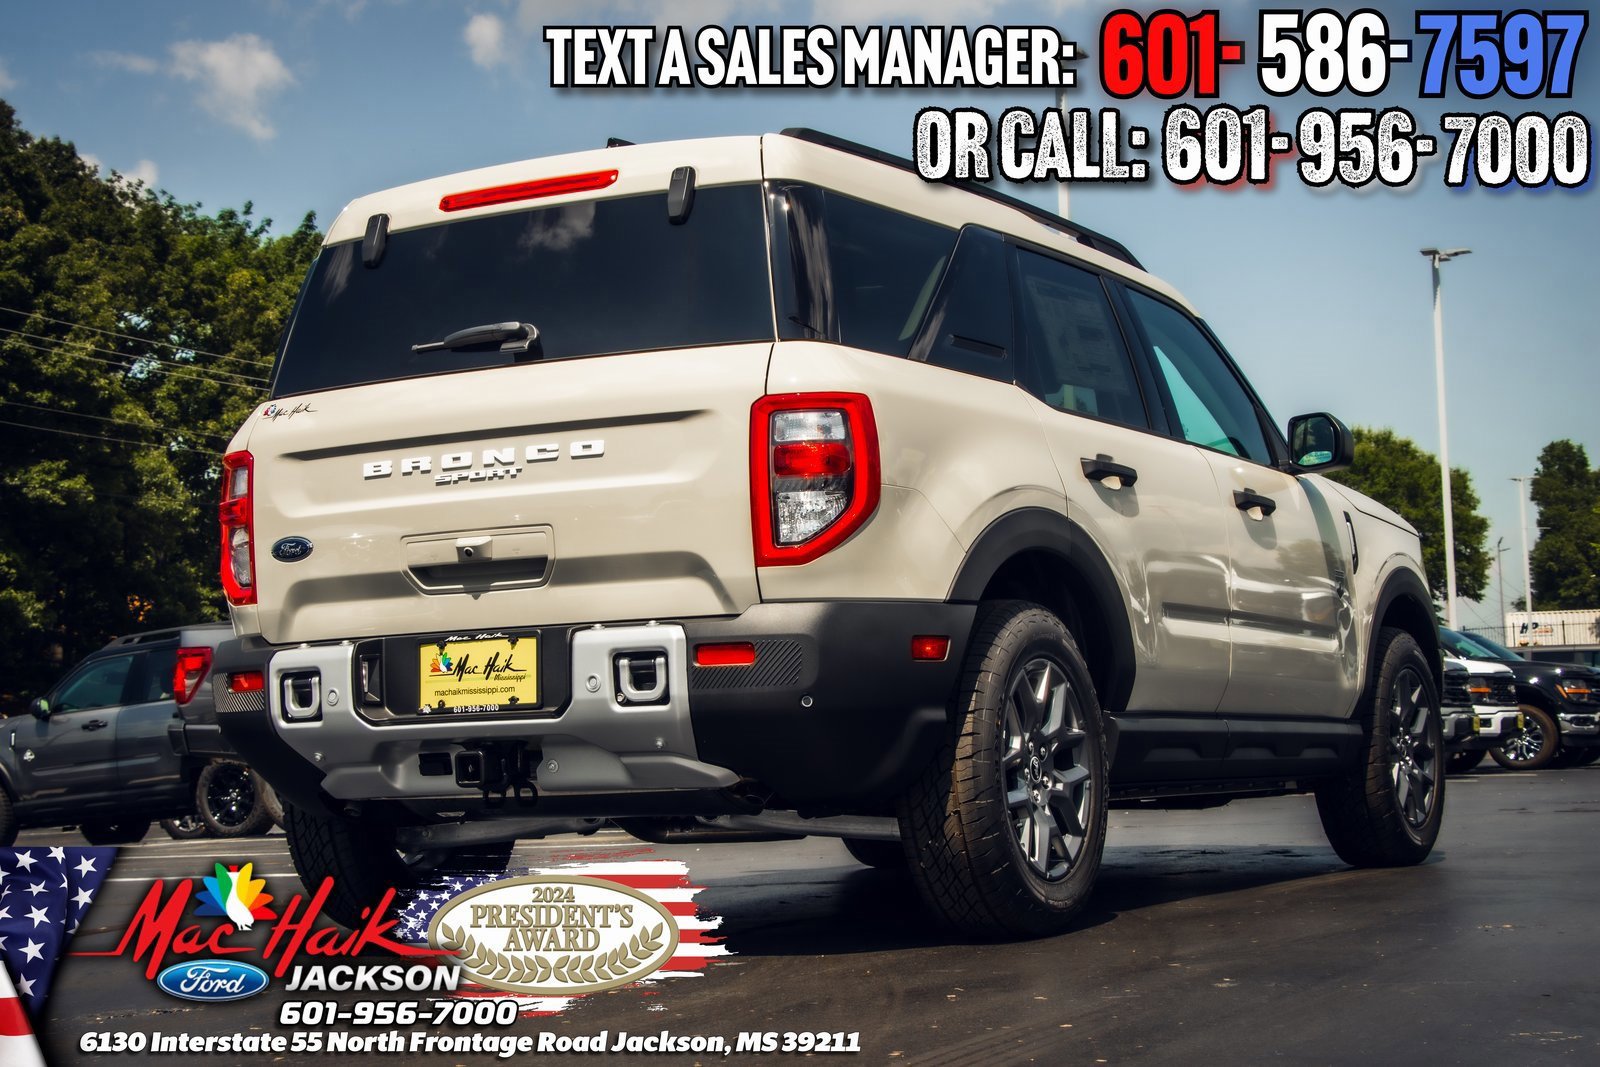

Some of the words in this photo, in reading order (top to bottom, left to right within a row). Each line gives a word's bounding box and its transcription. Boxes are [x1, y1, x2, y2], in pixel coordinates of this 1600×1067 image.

[363, 440, 605, 480] BRONCO
[434, 466, 523, 486] SPORT
[475, 632, 510, 641] Haik
[438, 654, 483, 682] Mac
[483, 652, 527, 681] Haik
[494, 672, 527, 683] Mississippi
[434, 685, 516, 697] machaikmississippi.com
[453, 704, 500, 714] 601-956-7000
